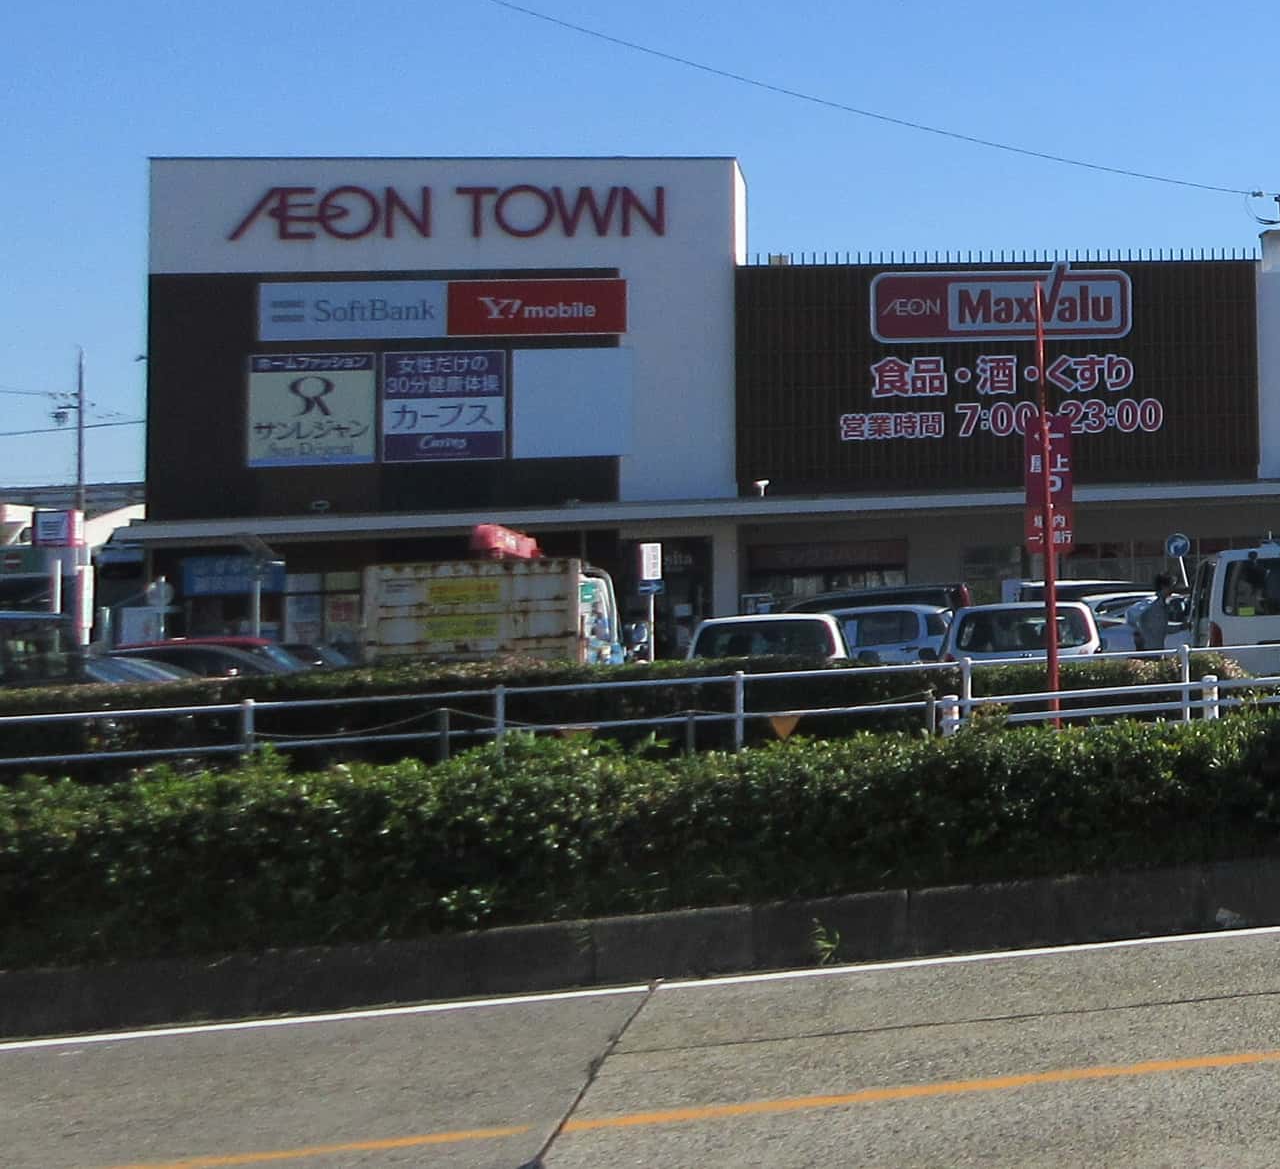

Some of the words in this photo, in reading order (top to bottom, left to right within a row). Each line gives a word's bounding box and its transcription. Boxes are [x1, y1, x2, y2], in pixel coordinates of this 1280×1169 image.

[456, 185, 666, 238] TOWN
[313, 299, 435, 323] SoftBank
[957, 266, 1114, 324] MaxValu
[839, 412, 945, 441] 営業時間
